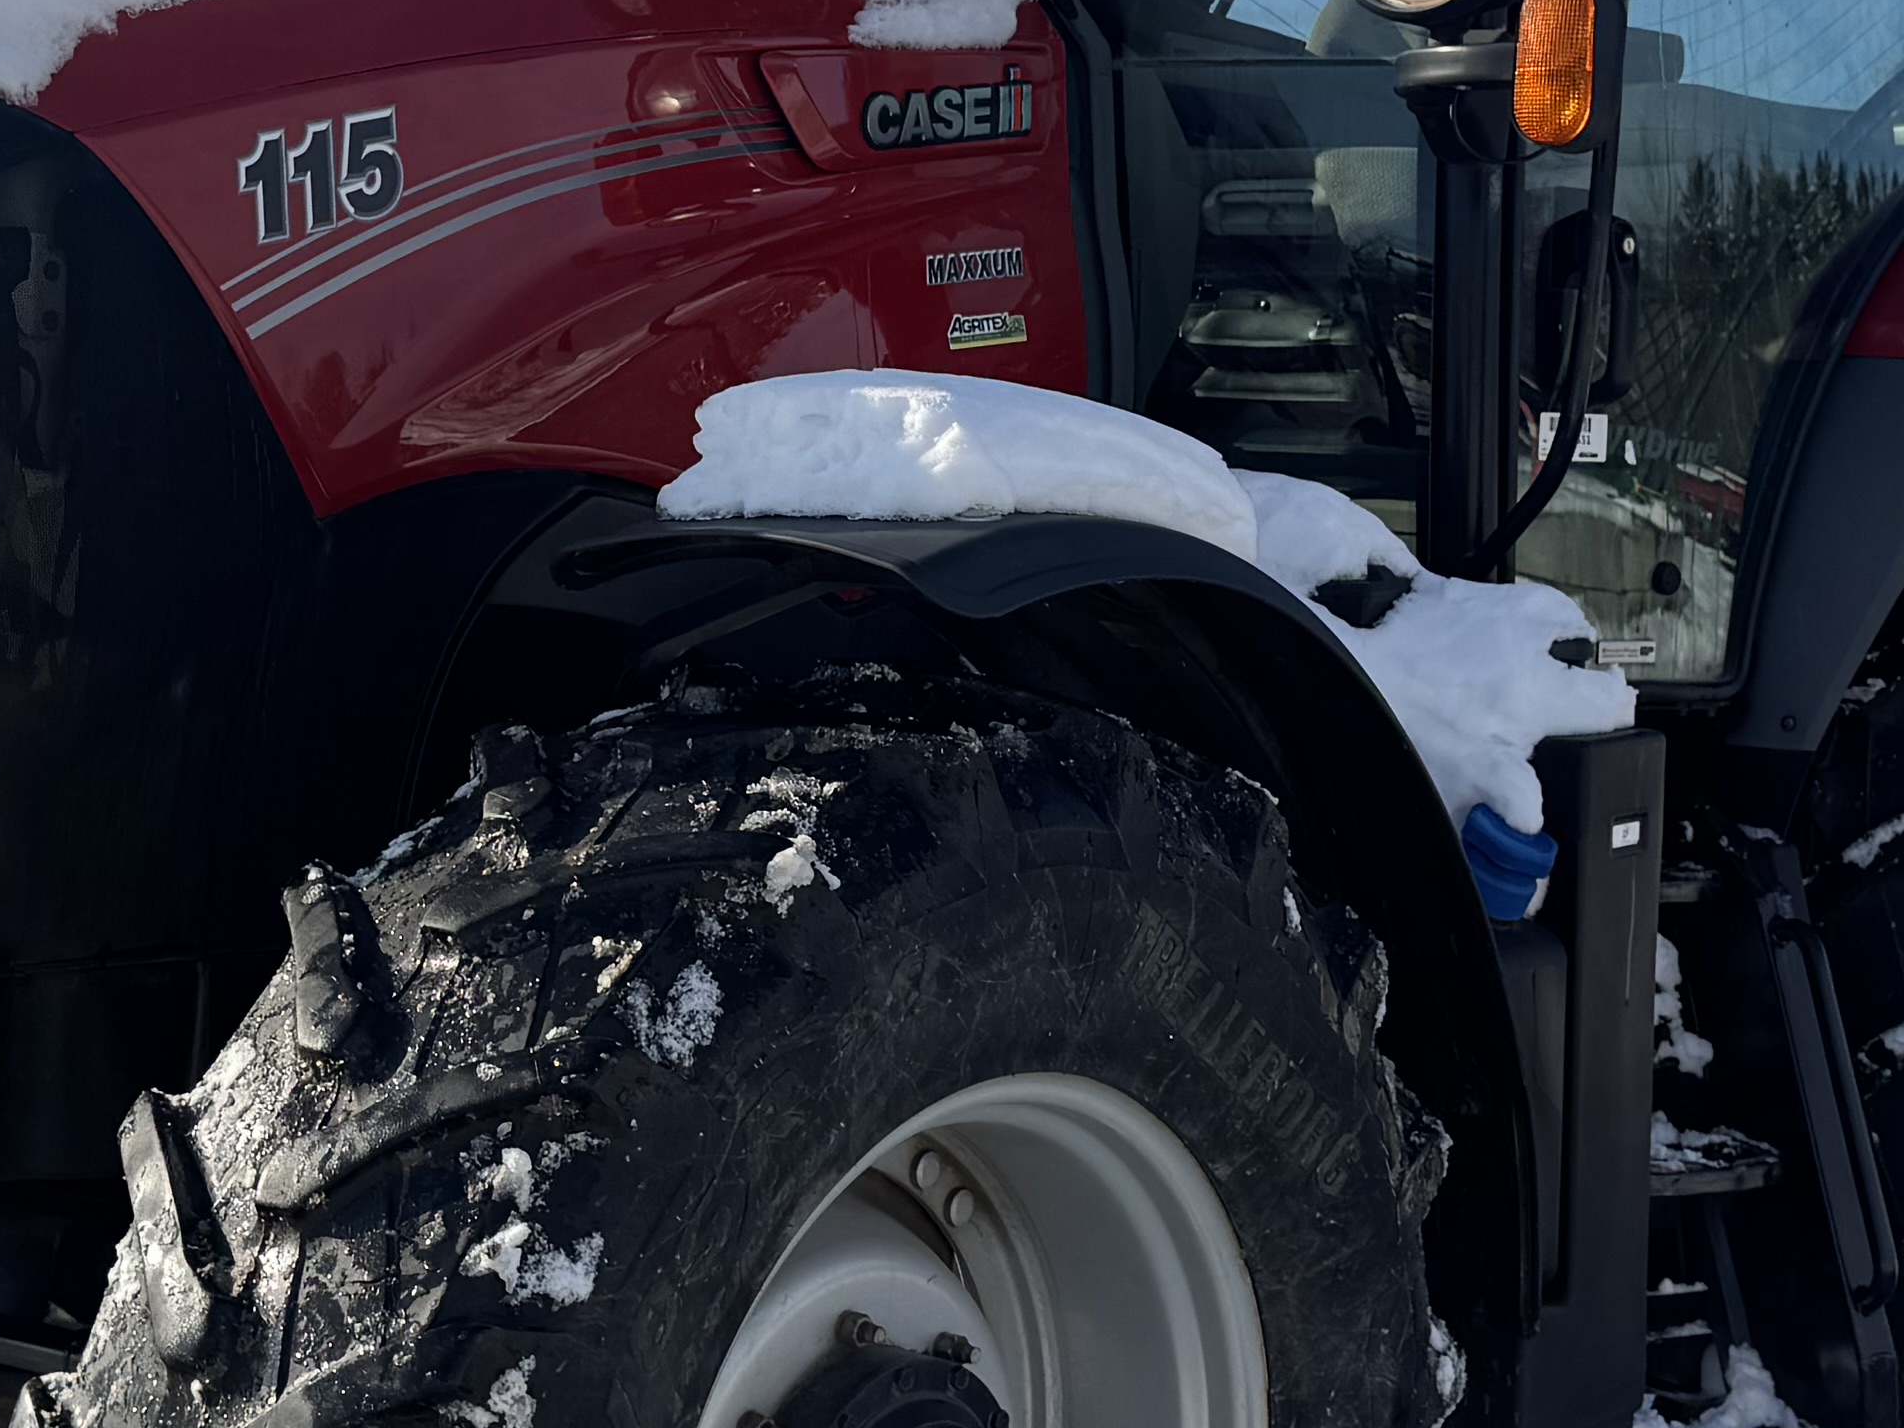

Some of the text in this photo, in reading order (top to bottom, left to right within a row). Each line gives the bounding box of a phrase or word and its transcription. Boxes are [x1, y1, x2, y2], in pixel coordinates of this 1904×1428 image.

[237, 104, 404, 245] 115
[926, 248, 1024, 285] MAXXUM
[950, 315, 1010, 335] AGRITEX
[1608, 424, 1719, 466] VXDrive
